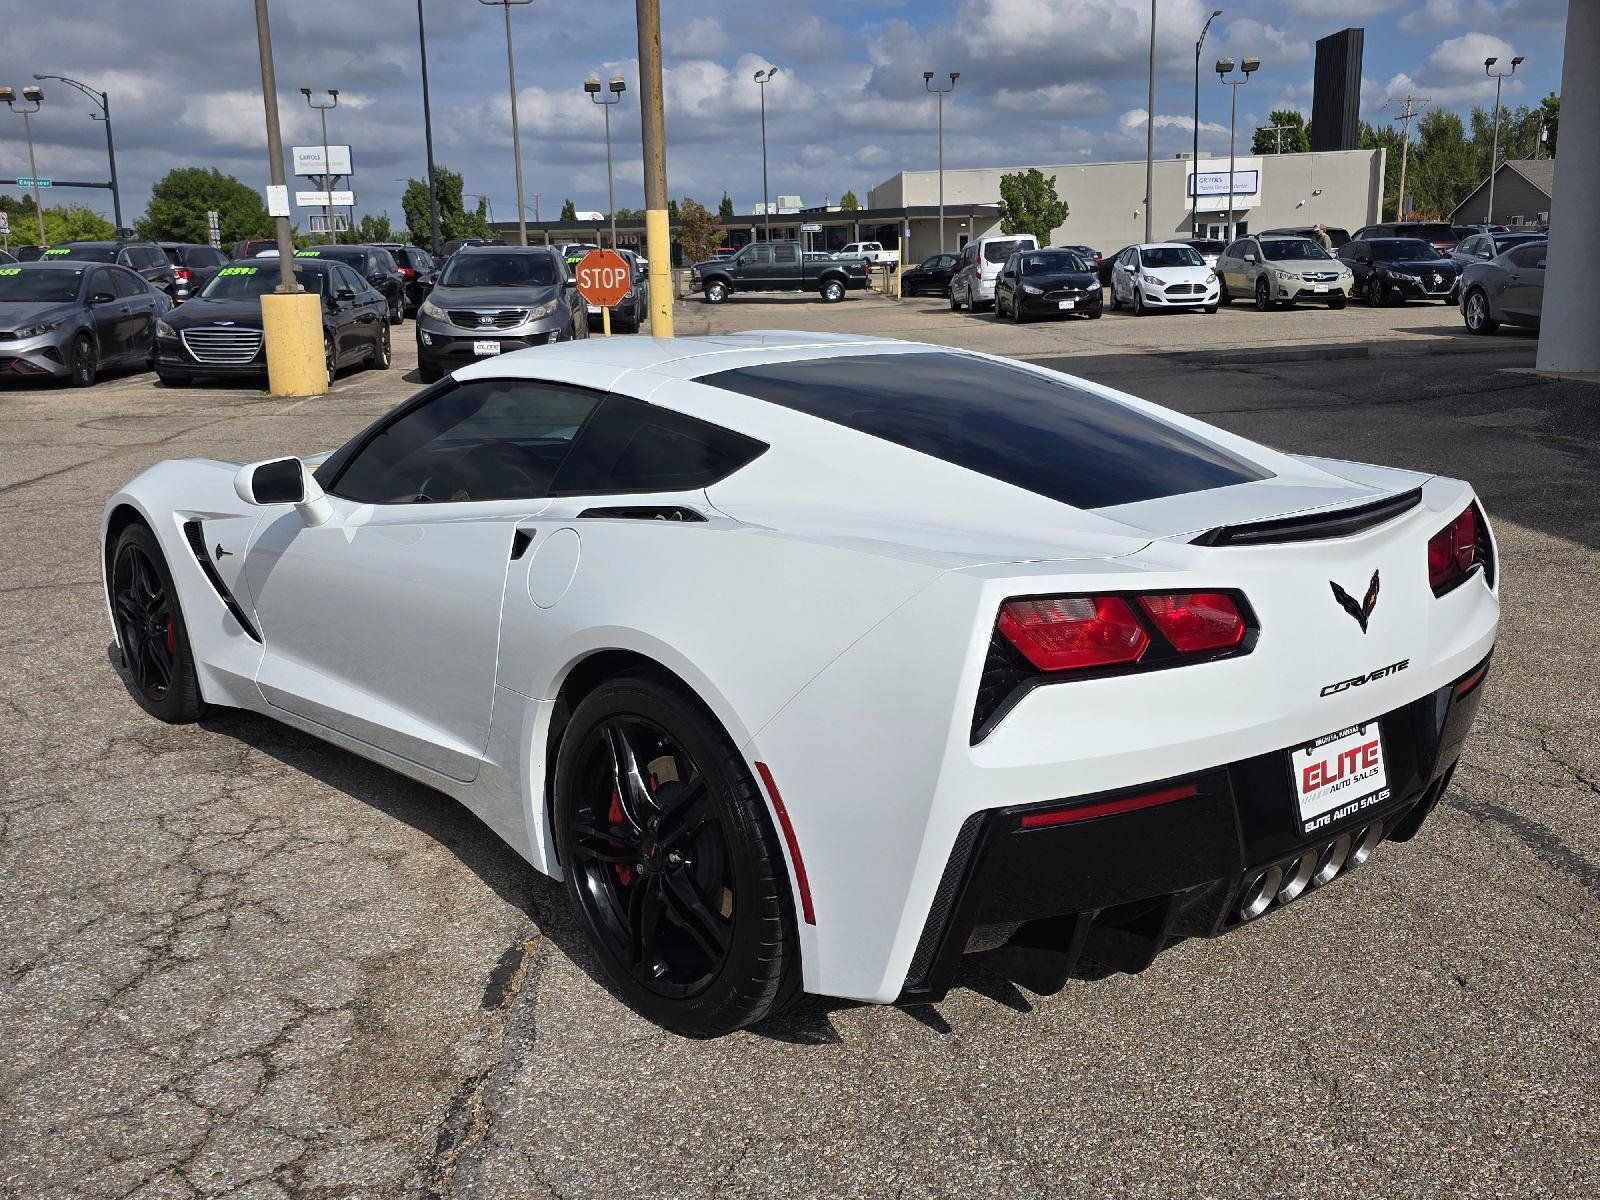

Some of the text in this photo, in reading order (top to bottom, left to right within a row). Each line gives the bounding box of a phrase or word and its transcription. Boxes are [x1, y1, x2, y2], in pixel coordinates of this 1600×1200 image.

[580, 268, 626, 289] STOP
[1319, 658, 1411, 698] CORVETTE
[1338, 724, 1360, 739] KANSAS
[1302, 739, 1379, 795] ELITE
[1329, 766, 1379, 794] AUTO SALES
[1304, 788, 1391, 834] ELITE AUTO SALES
